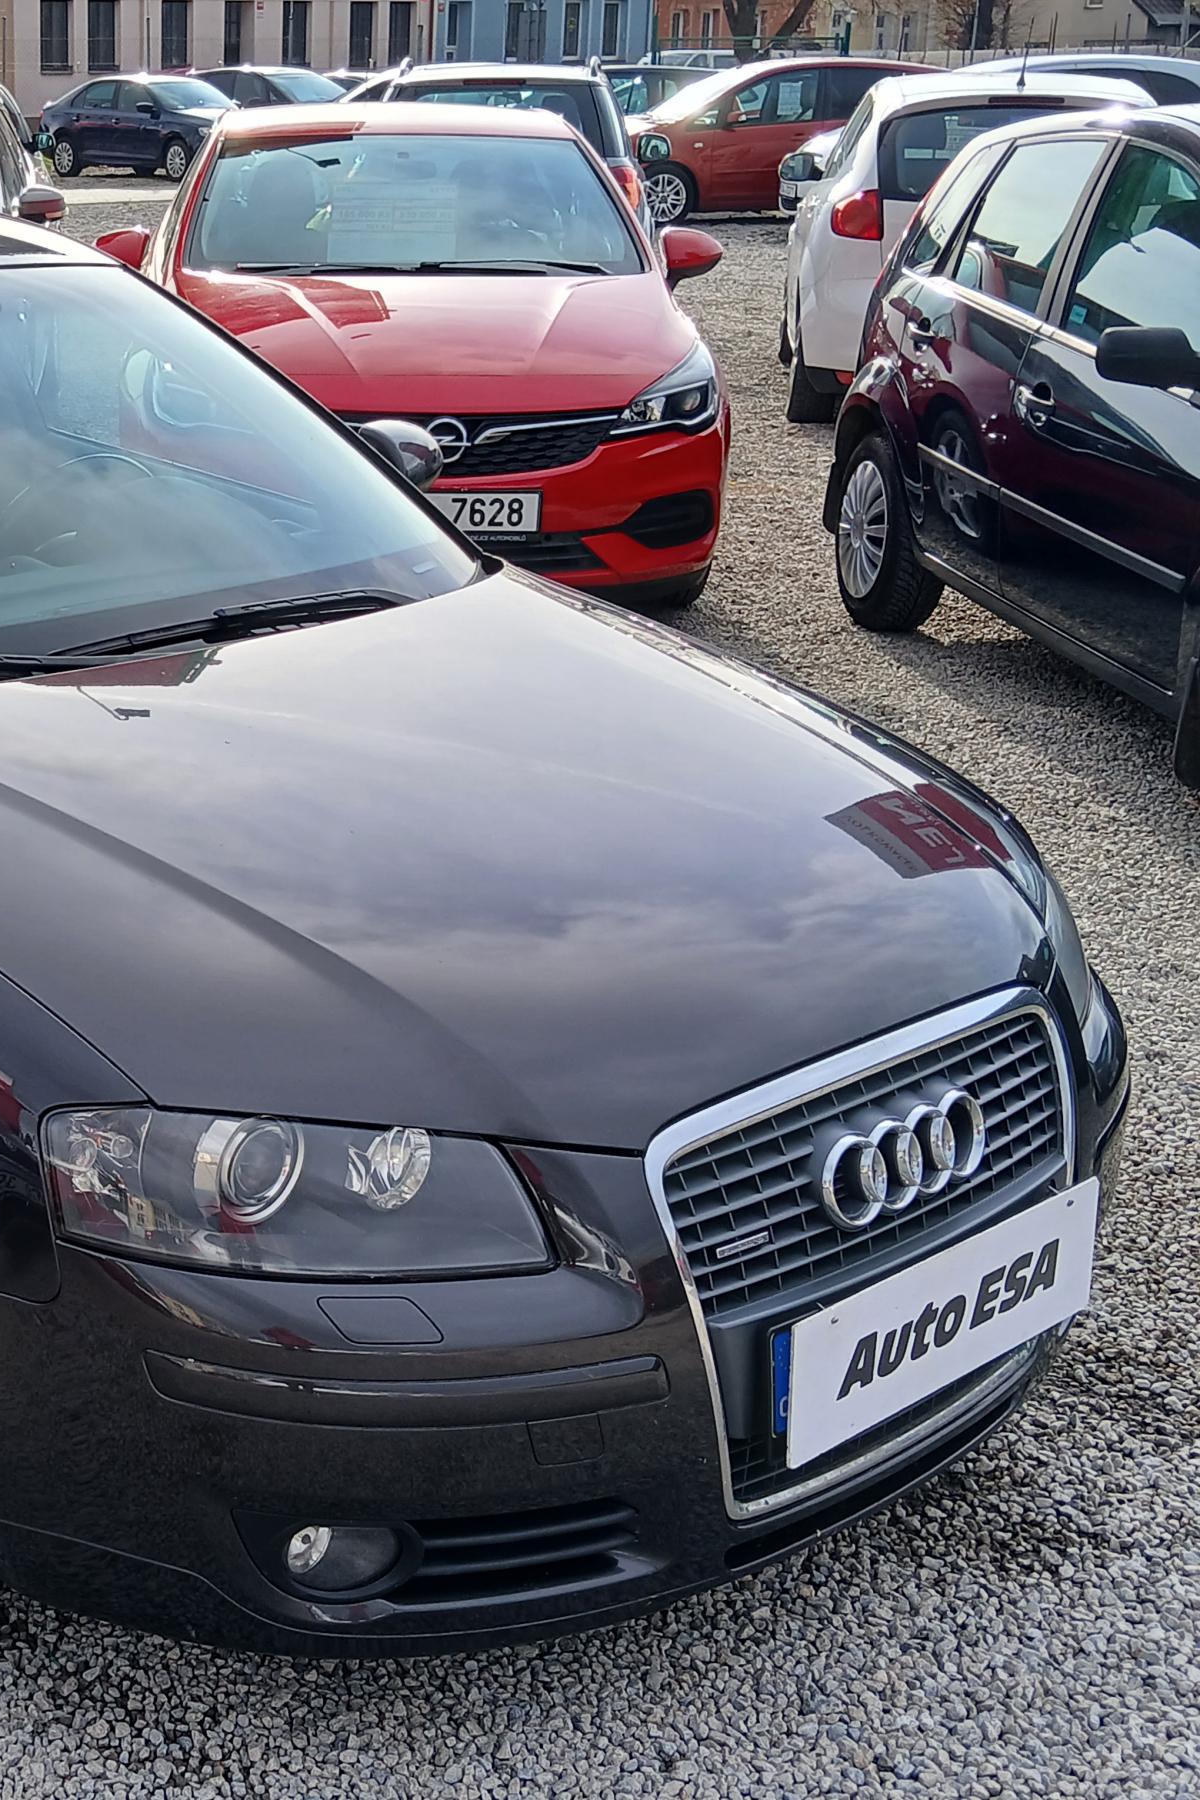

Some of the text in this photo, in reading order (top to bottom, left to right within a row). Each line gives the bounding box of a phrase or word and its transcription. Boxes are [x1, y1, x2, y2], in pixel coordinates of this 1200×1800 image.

[451, 498, 524, 527] 7628
[836, 1238, 1060, 1401] Auto ESA
